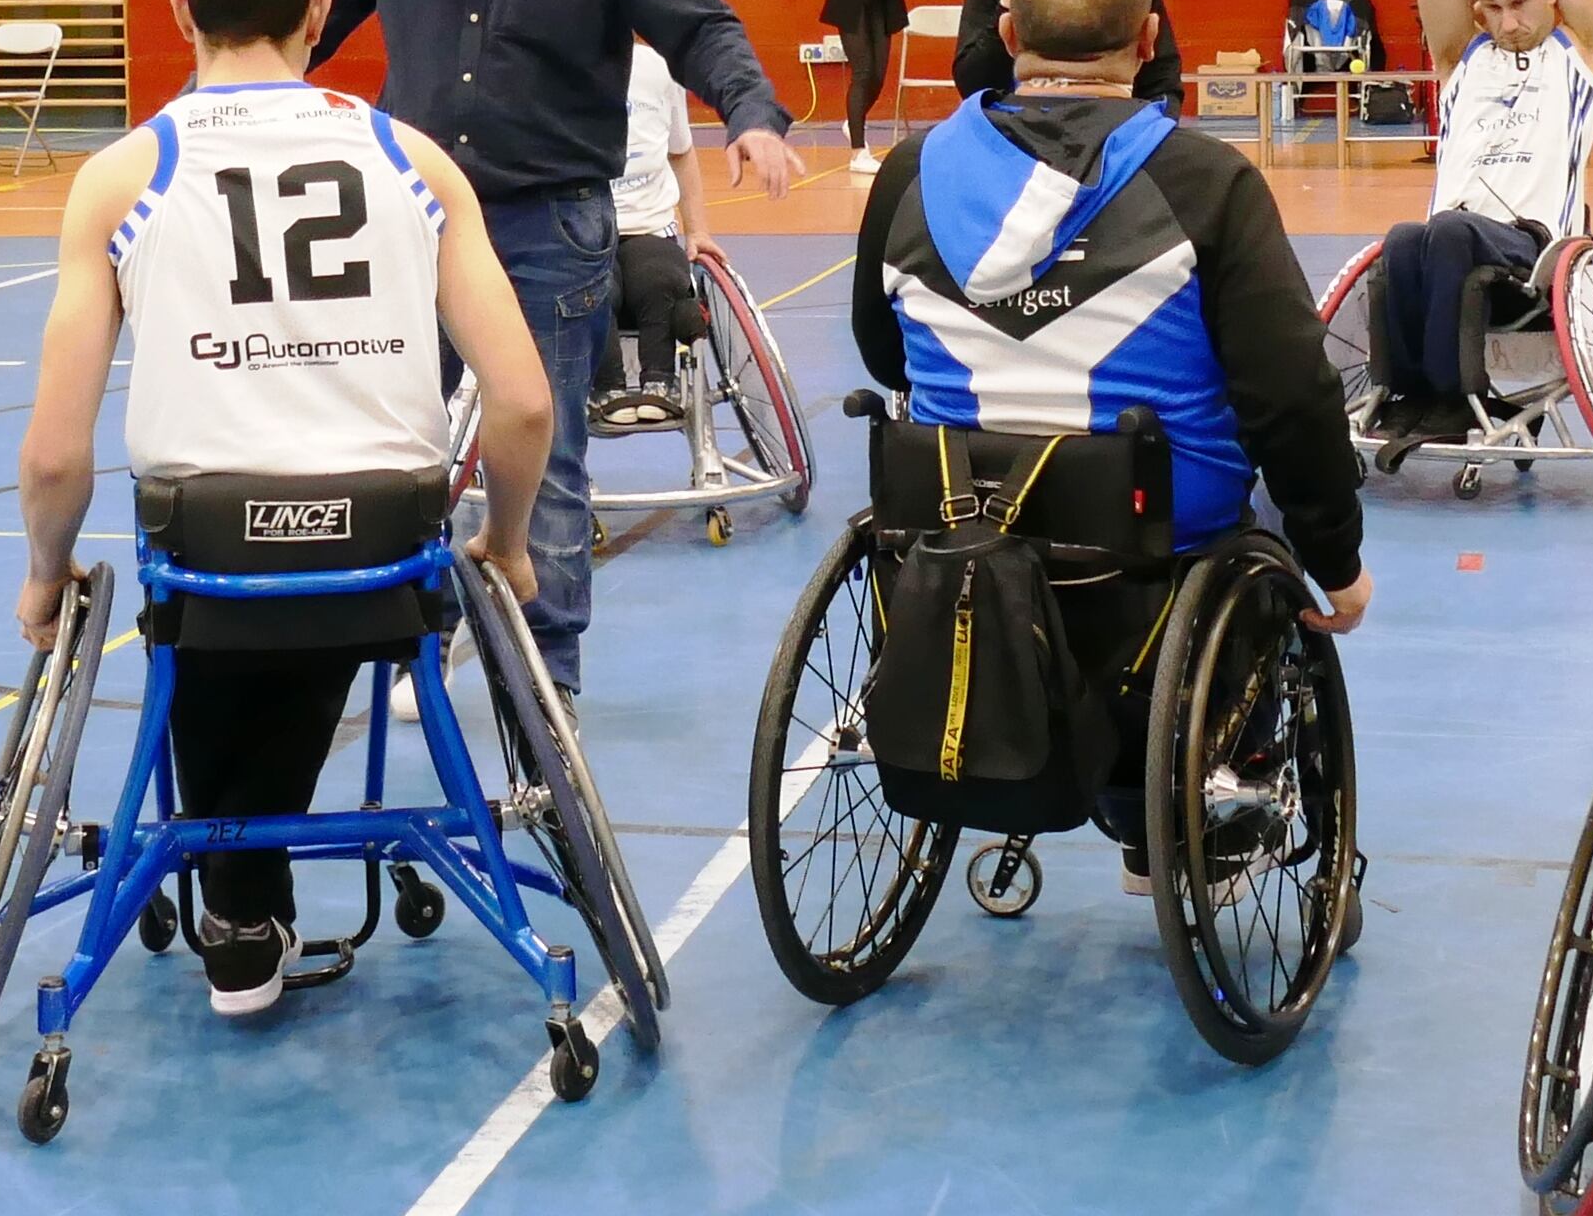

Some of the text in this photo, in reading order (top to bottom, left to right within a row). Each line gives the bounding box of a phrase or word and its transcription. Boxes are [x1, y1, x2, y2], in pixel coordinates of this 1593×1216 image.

[215, 160, 371, 305] 12
[245, 333, 405, 361] Automotive
[252, 504, 345, 529] LINCE
